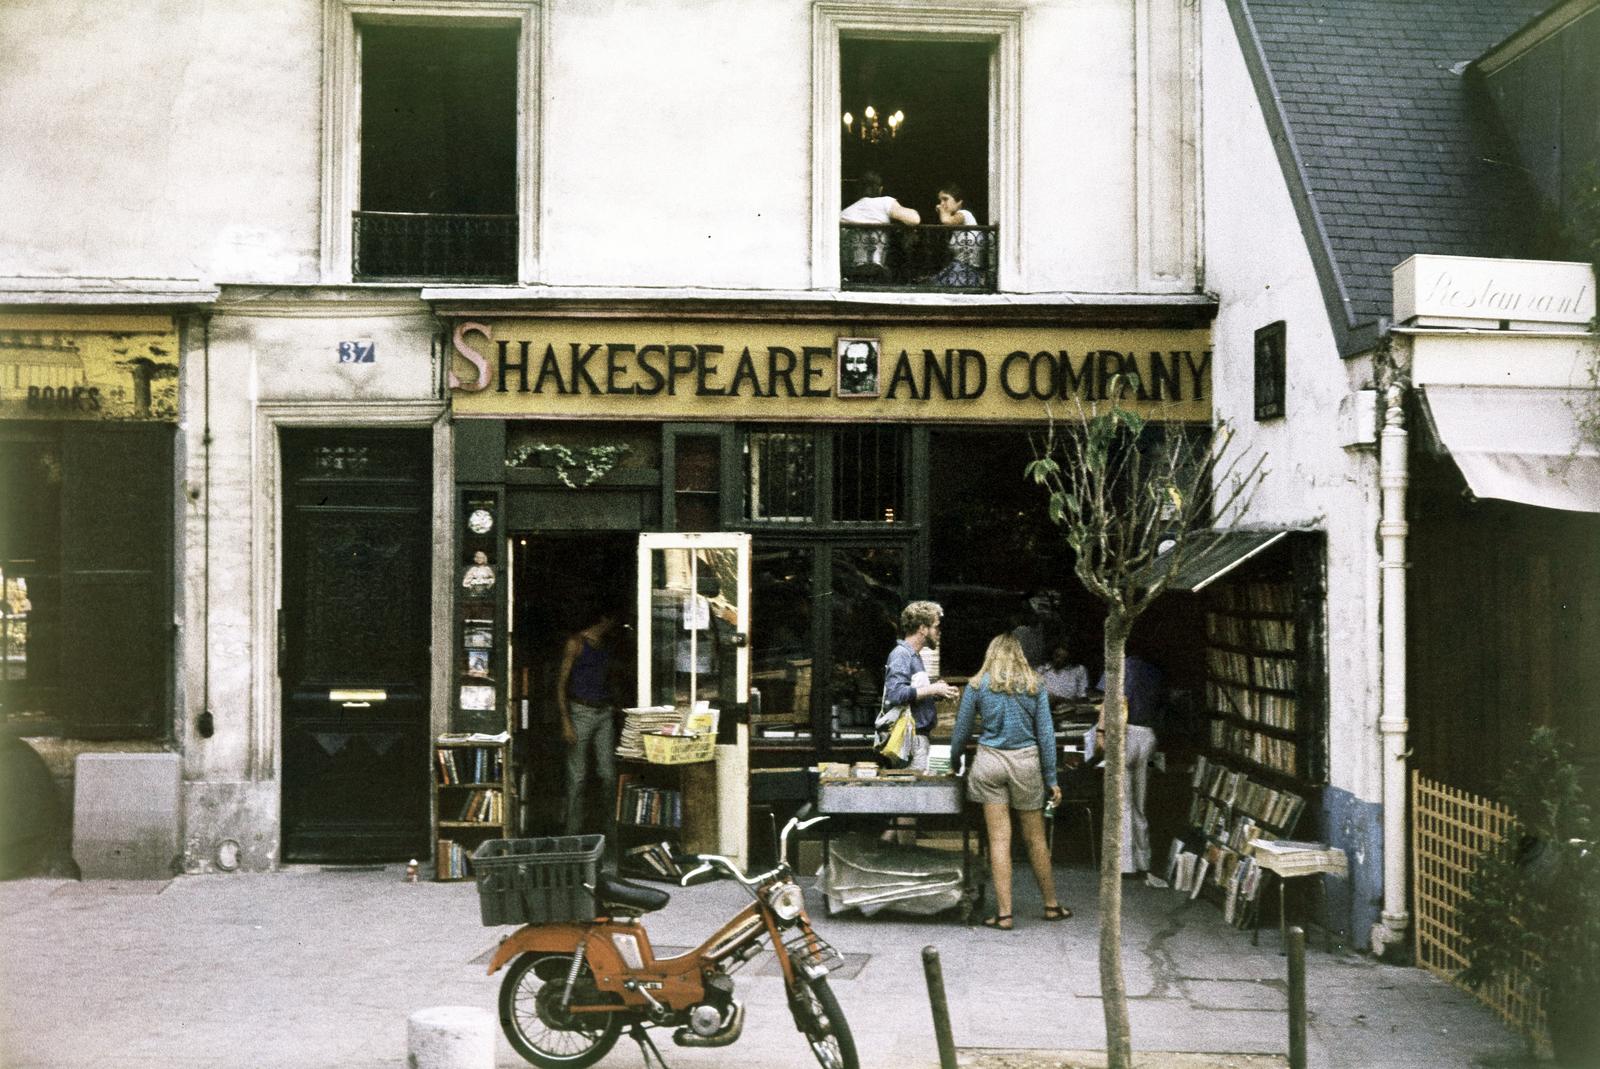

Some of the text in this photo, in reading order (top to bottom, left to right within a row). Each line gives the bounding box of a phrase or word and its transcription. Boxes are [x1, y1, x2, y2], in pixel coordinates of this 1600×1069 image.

[342, 341, 373, 363] 37
[448, 321, 1213, 401] SHAKESPEARE AND COMPANY
